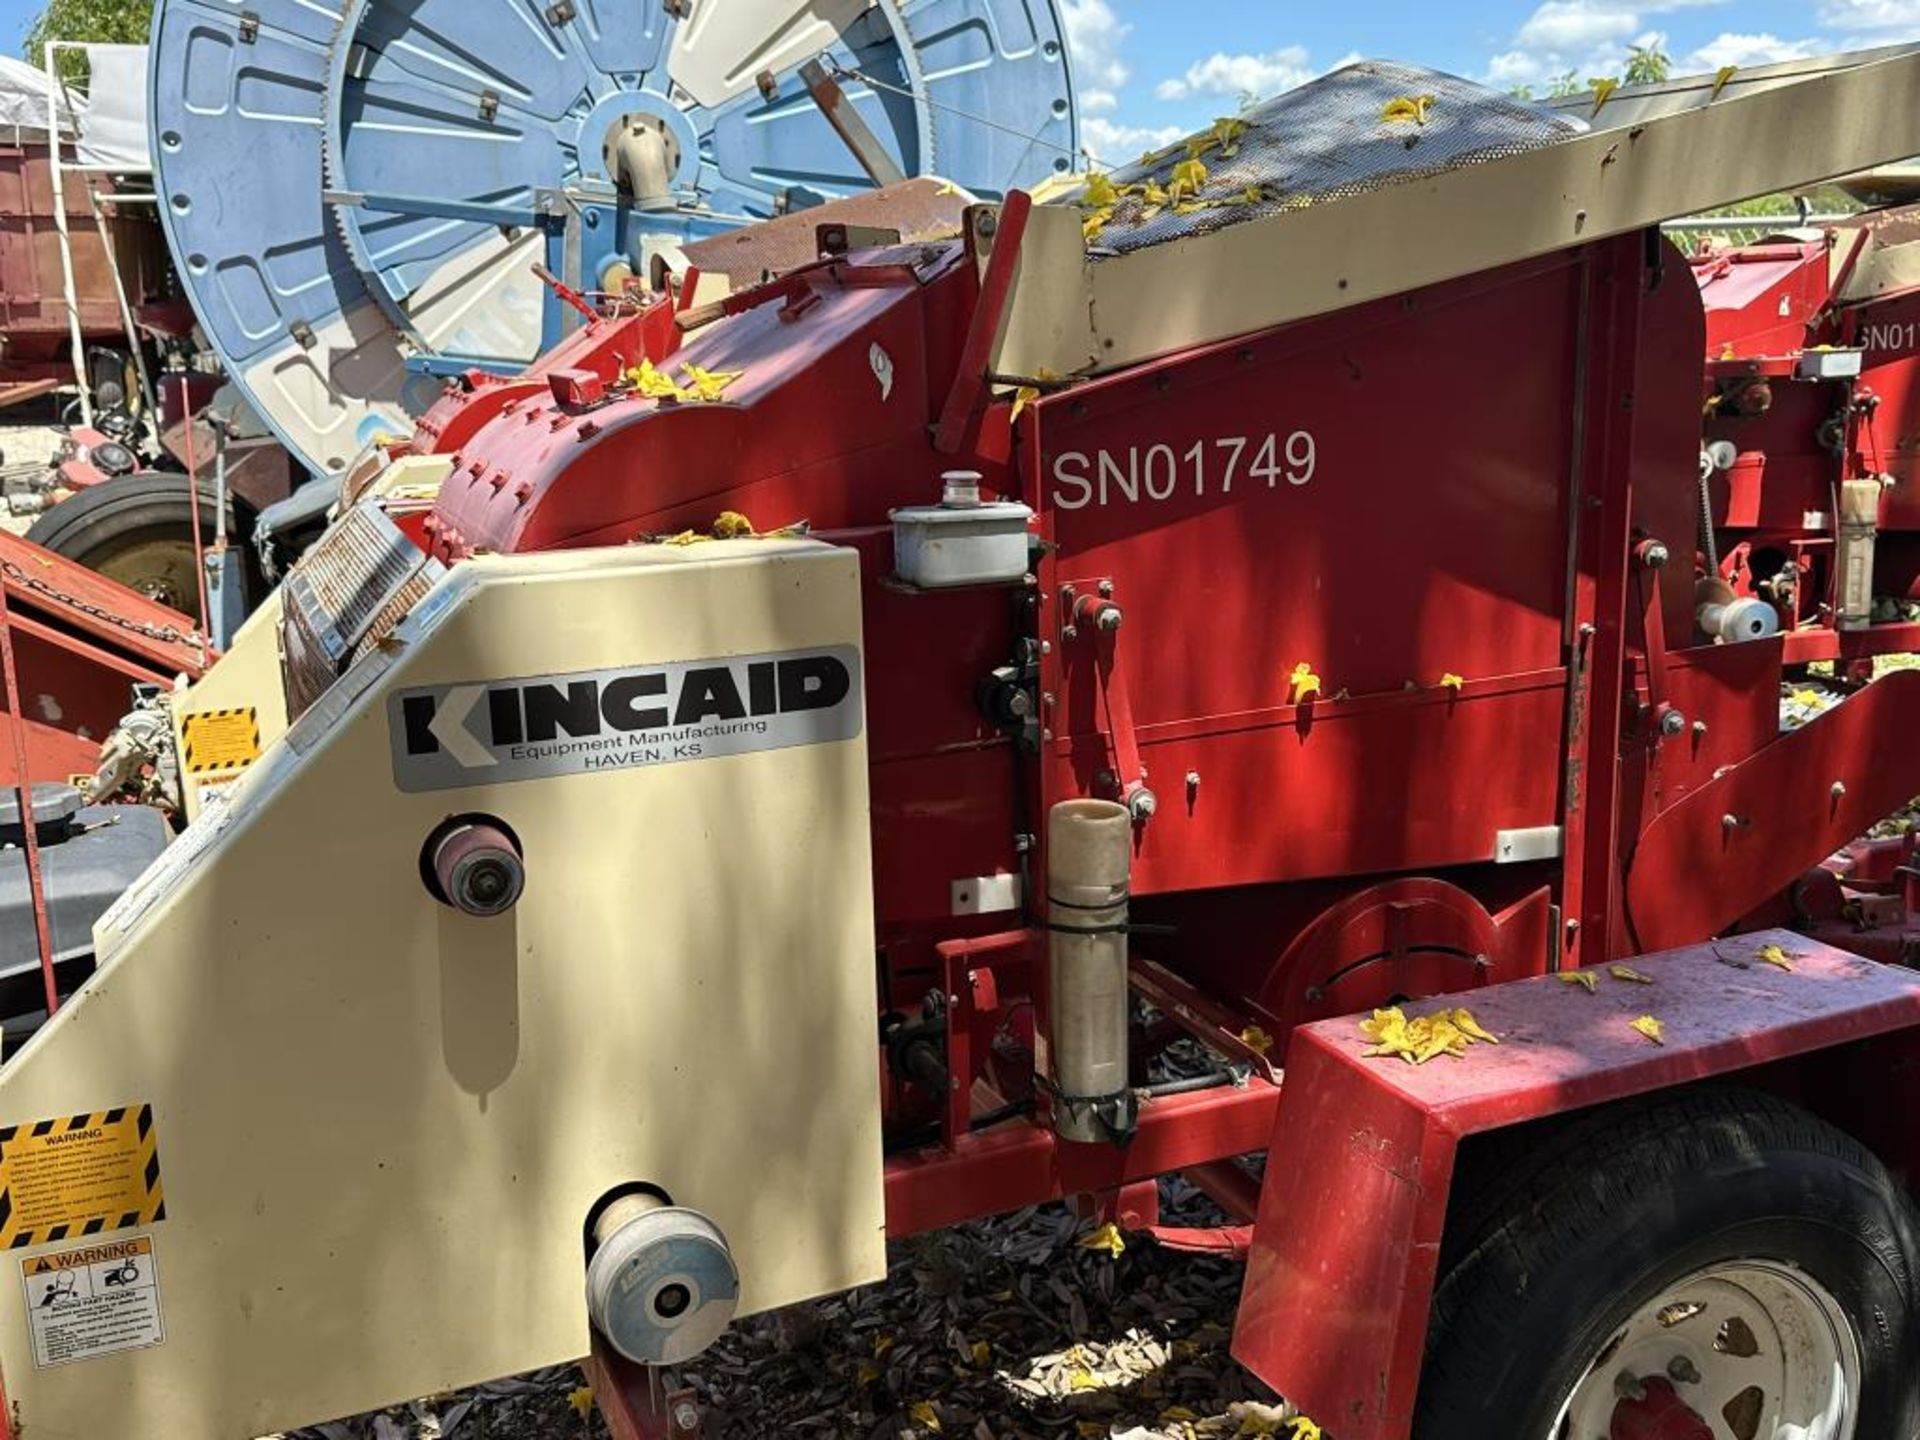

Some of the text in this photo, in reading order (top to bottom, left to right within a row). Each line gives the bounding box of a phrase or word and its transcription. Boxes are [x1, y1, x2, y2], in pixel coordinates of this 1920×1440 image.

[1860, 323, 1920, 351] SN01
[1052, 430, 1316, 510] SN01749
[402, 655, 851, 768] KINCAID
[510, 719, 767, 761] Equipment Manufacturing
[673, 743, 703, 758] KS
[45, 1128, 103, 1146] WARNING
[56, 1242, 139, 1268] WARNING
